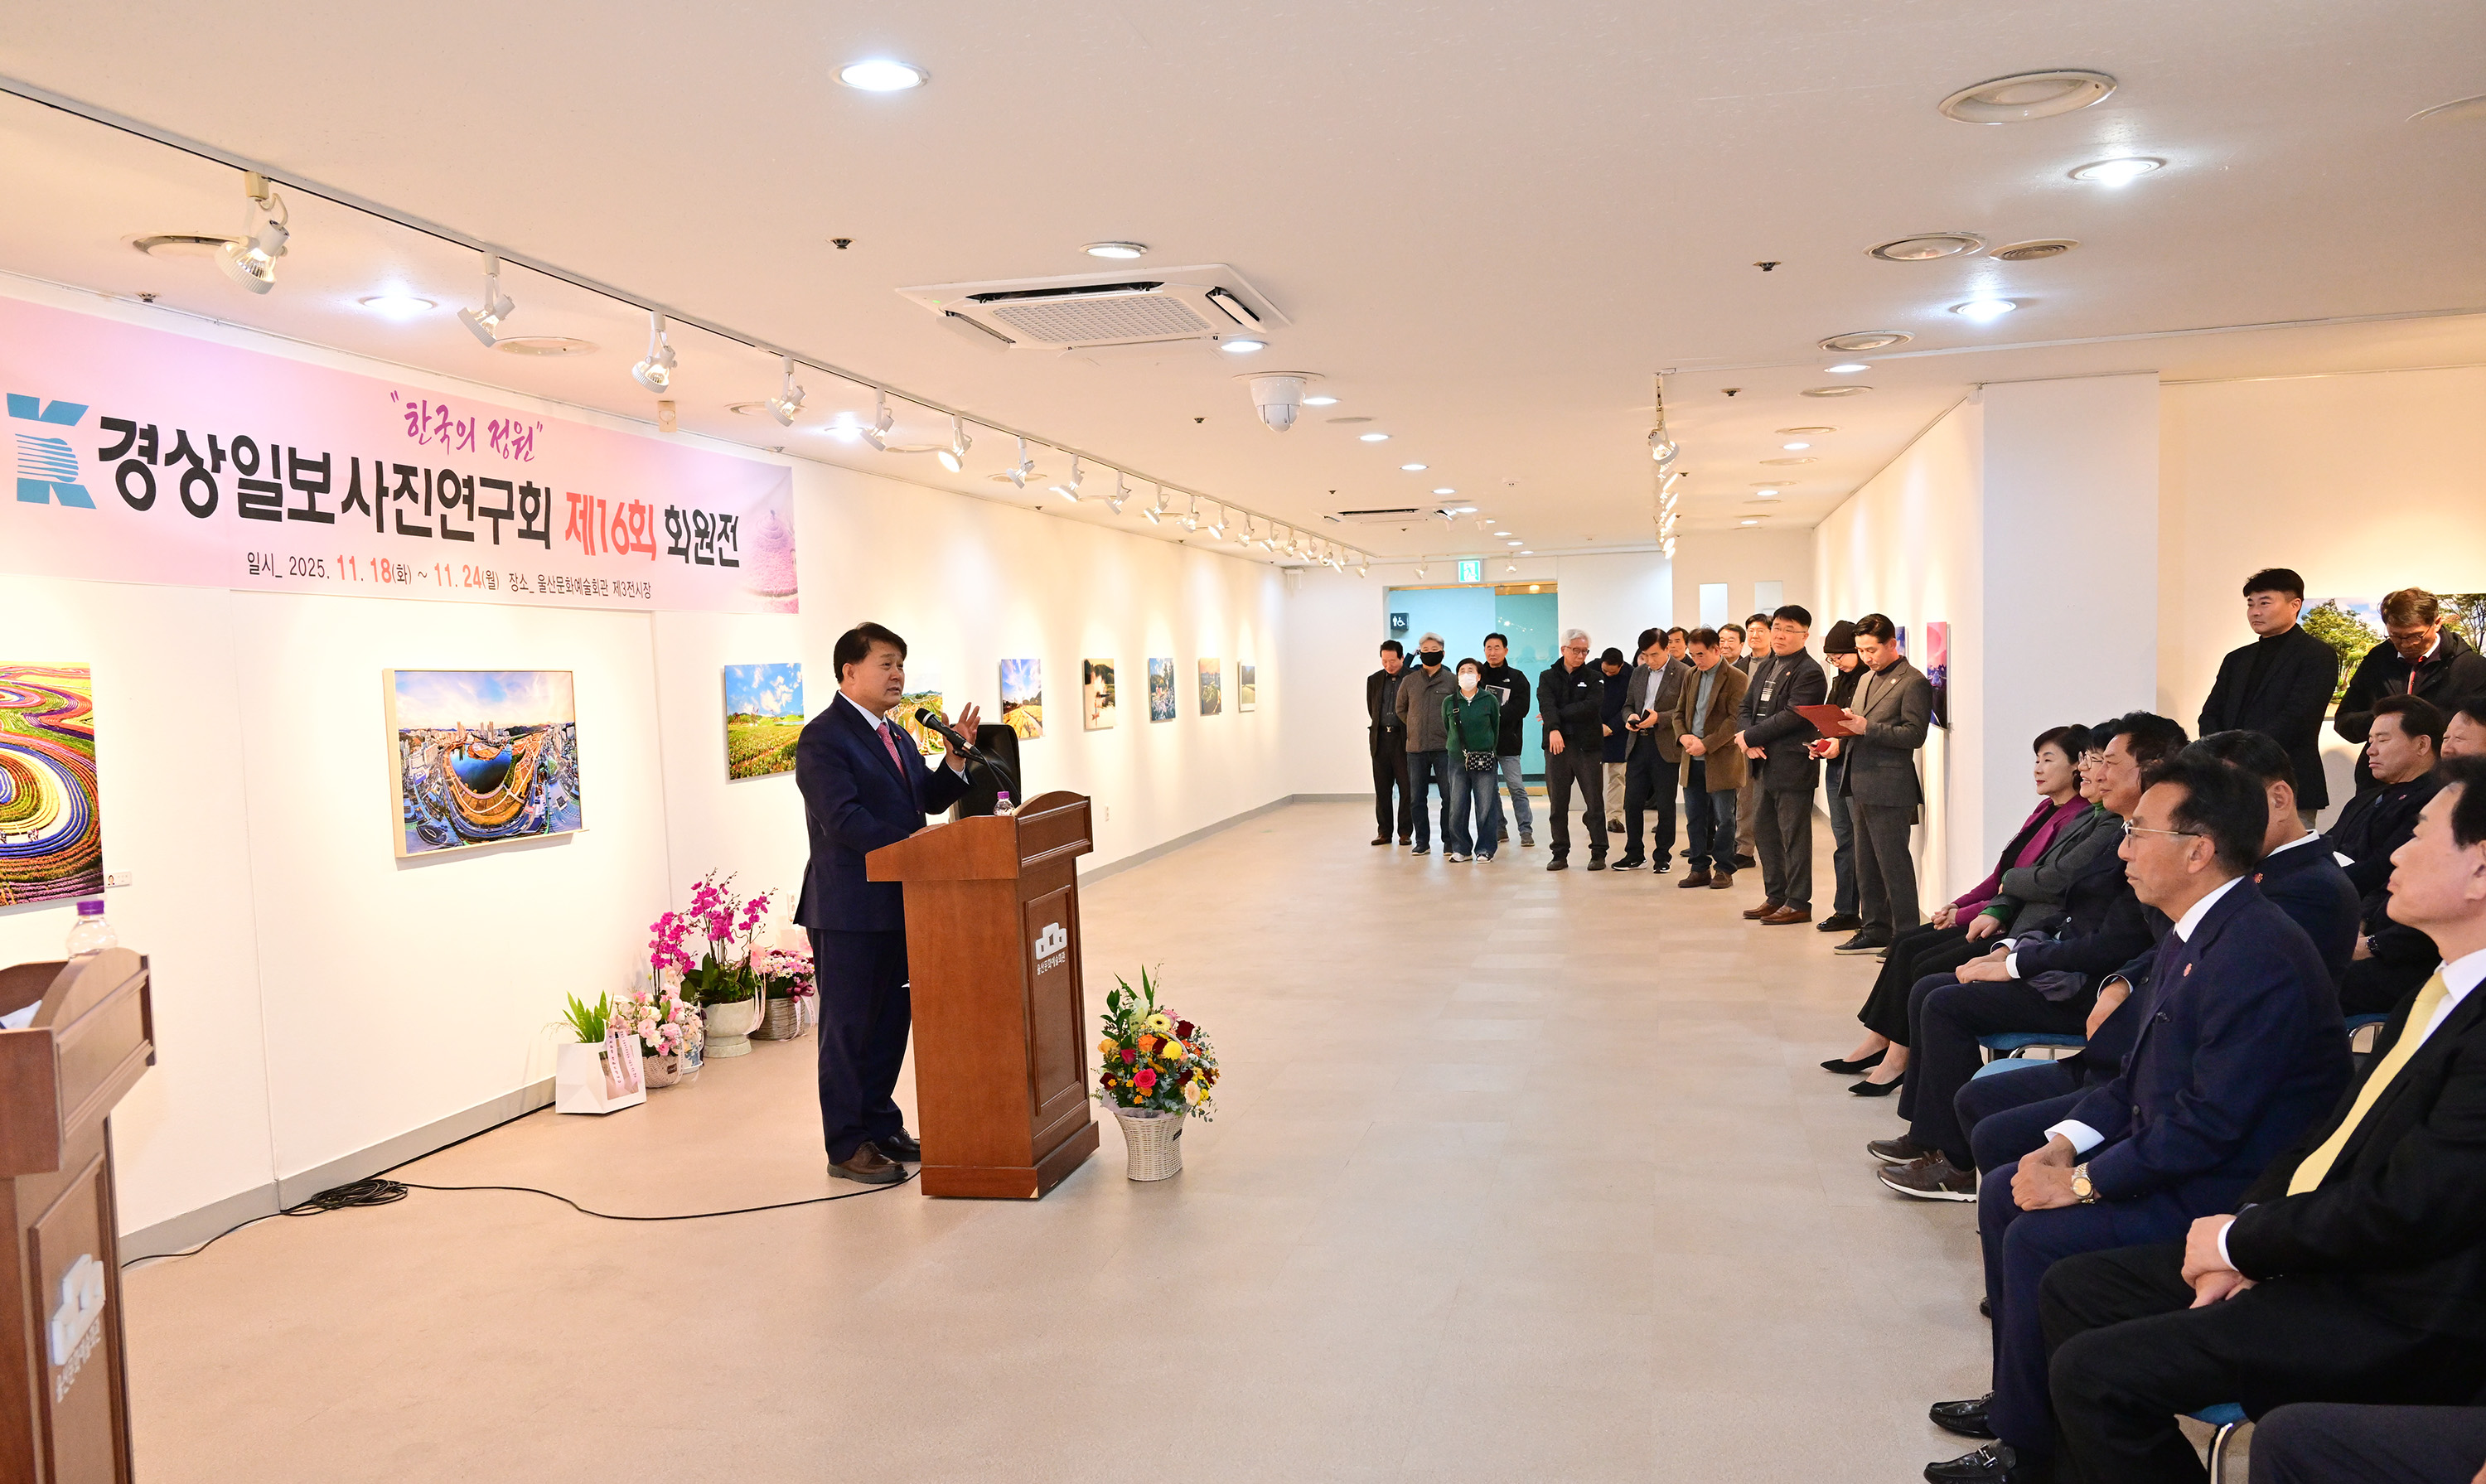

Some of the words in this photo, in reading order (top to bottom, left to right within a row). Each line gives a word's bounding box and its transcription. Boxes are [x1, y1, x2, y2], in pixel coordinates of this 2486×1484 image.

[98, 416, 551, 549] 경상일보사진연구회
[565, 491, 656, 561] 제16회
[665, 505, 740, 568] 회원전
[289, 556, 330, 579] 2025.
[370, 557, 412, 585] 18(화)
[462, 564, 500, 591] 24(월)
[537, 573, 609, 597] 울산문화예술회관
[612, 580, 651, 599] 제3전시장
